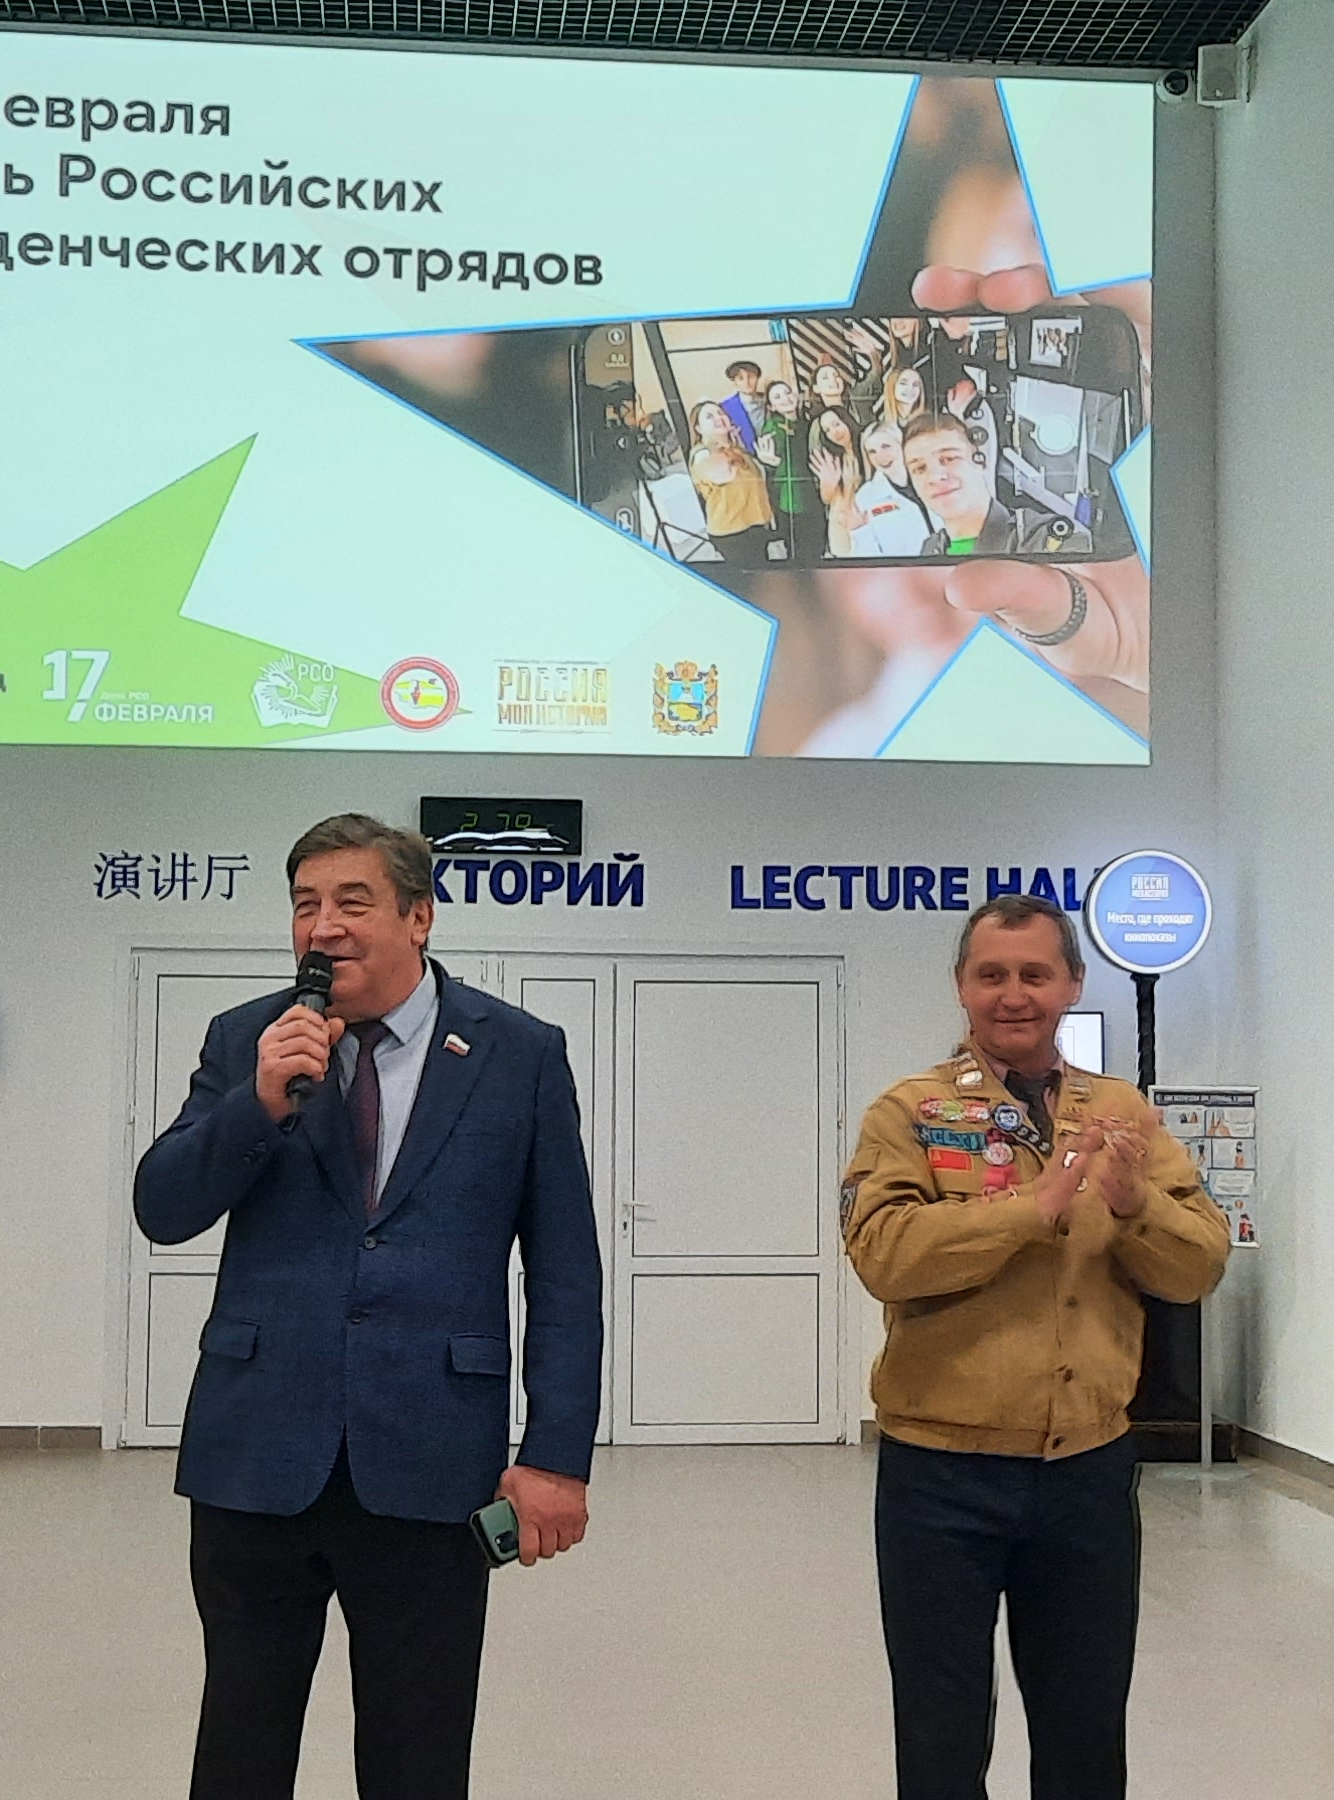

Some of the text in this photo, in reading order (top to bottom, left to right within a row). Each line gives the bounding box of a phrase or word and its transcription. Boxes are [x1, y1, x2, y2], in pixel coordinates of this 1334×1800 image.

[58, 154, 443, 213] Российских
[344, 245, 605, 291] отрядов
[41, 649, 110, 723] 17
[297, 663, 335, 683] РСО
[497, 666, 607, 703] РОССИЯ
[94, 702, 214, 724] ФЕВРАЛЯ
[93, 852, 250, 901] 演讲厅
[432, 852, 645, 907] КТОРИЙ
[730, 865, 1103, 911] LECTURE HAL
